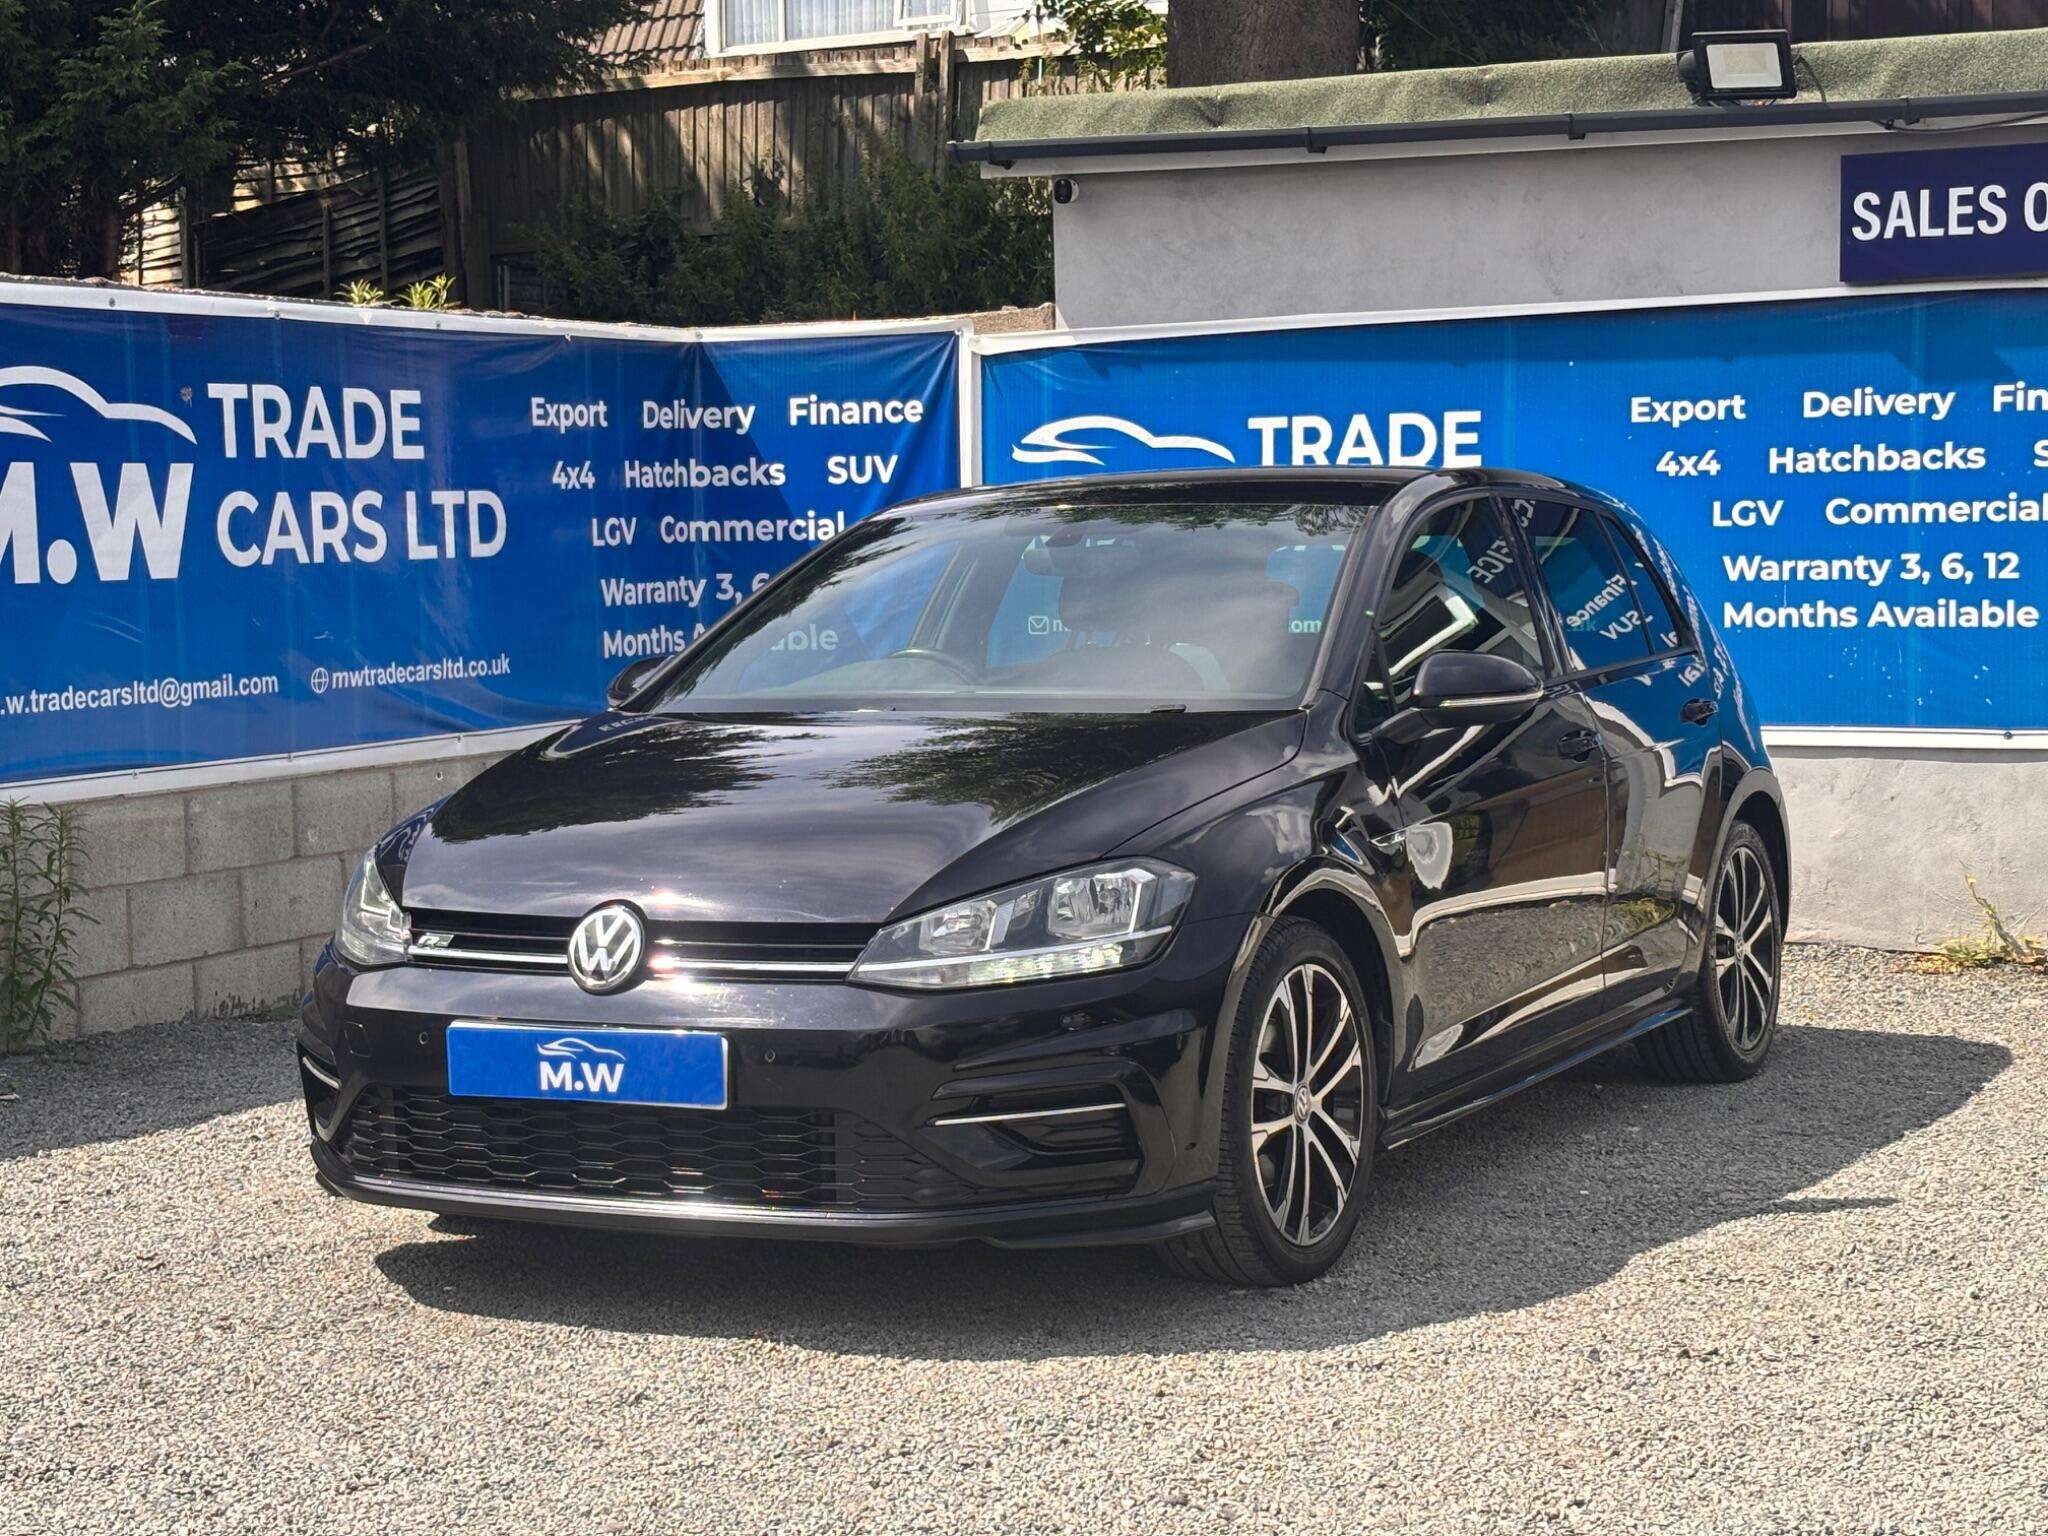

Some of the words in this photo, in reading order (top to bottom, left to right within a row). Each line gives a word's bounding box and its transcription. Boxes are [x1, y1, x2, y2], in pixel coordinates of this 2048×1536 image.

[1852, 185, 2007, 241] SALES
[2024, 182, 2048, 232] O
[207, 383, 425, 460] TRADE
[531, 397, 608, 433] Export
[643, 399, 755, 434] Delivery
[789, 394, 923, 426] Finance
[1631, 394, 1746, 427] Export
[1803, 387, 1955, 420] Delivery
[1248, 411, 1482, 467] TRADE
[552, 460, 595, 489] 4x4
[624, 457, 786, 488] Hatchbacks
[827, 454, 898, 485] SUV
[1656, 450, 1721, 476] 4x4
[1769, 441, 1985, 473] Hatchbacks
[1712, 500, 1784, 527] LGV
[1825, 492, 2048, 524] Commercial
[217, 490, 388, 567] CARS
[405, 490, 507, 560] LTD
[592, 517, 637, 546] LGV
[660, 510, 845, 543] Commercial
[1723, 555, 1891, 586] Warranty
[1900, 553, 1930, 584] 3,
[1941, 553, 1974, 584] 6,
[1984, 552, 2020, 579] 12
[601, 575, 707, 607] Warranty
[716, 573, 742, 605] 3,
[1723, 600, 1858, 628] Months
[1867, 599, 2039, 628] Available
[603, 624, 685, 659] Months
[331, 653, 511, 690] mwtradecarsltd.co.uk
[539, 1061, 624, 1093] M.W
